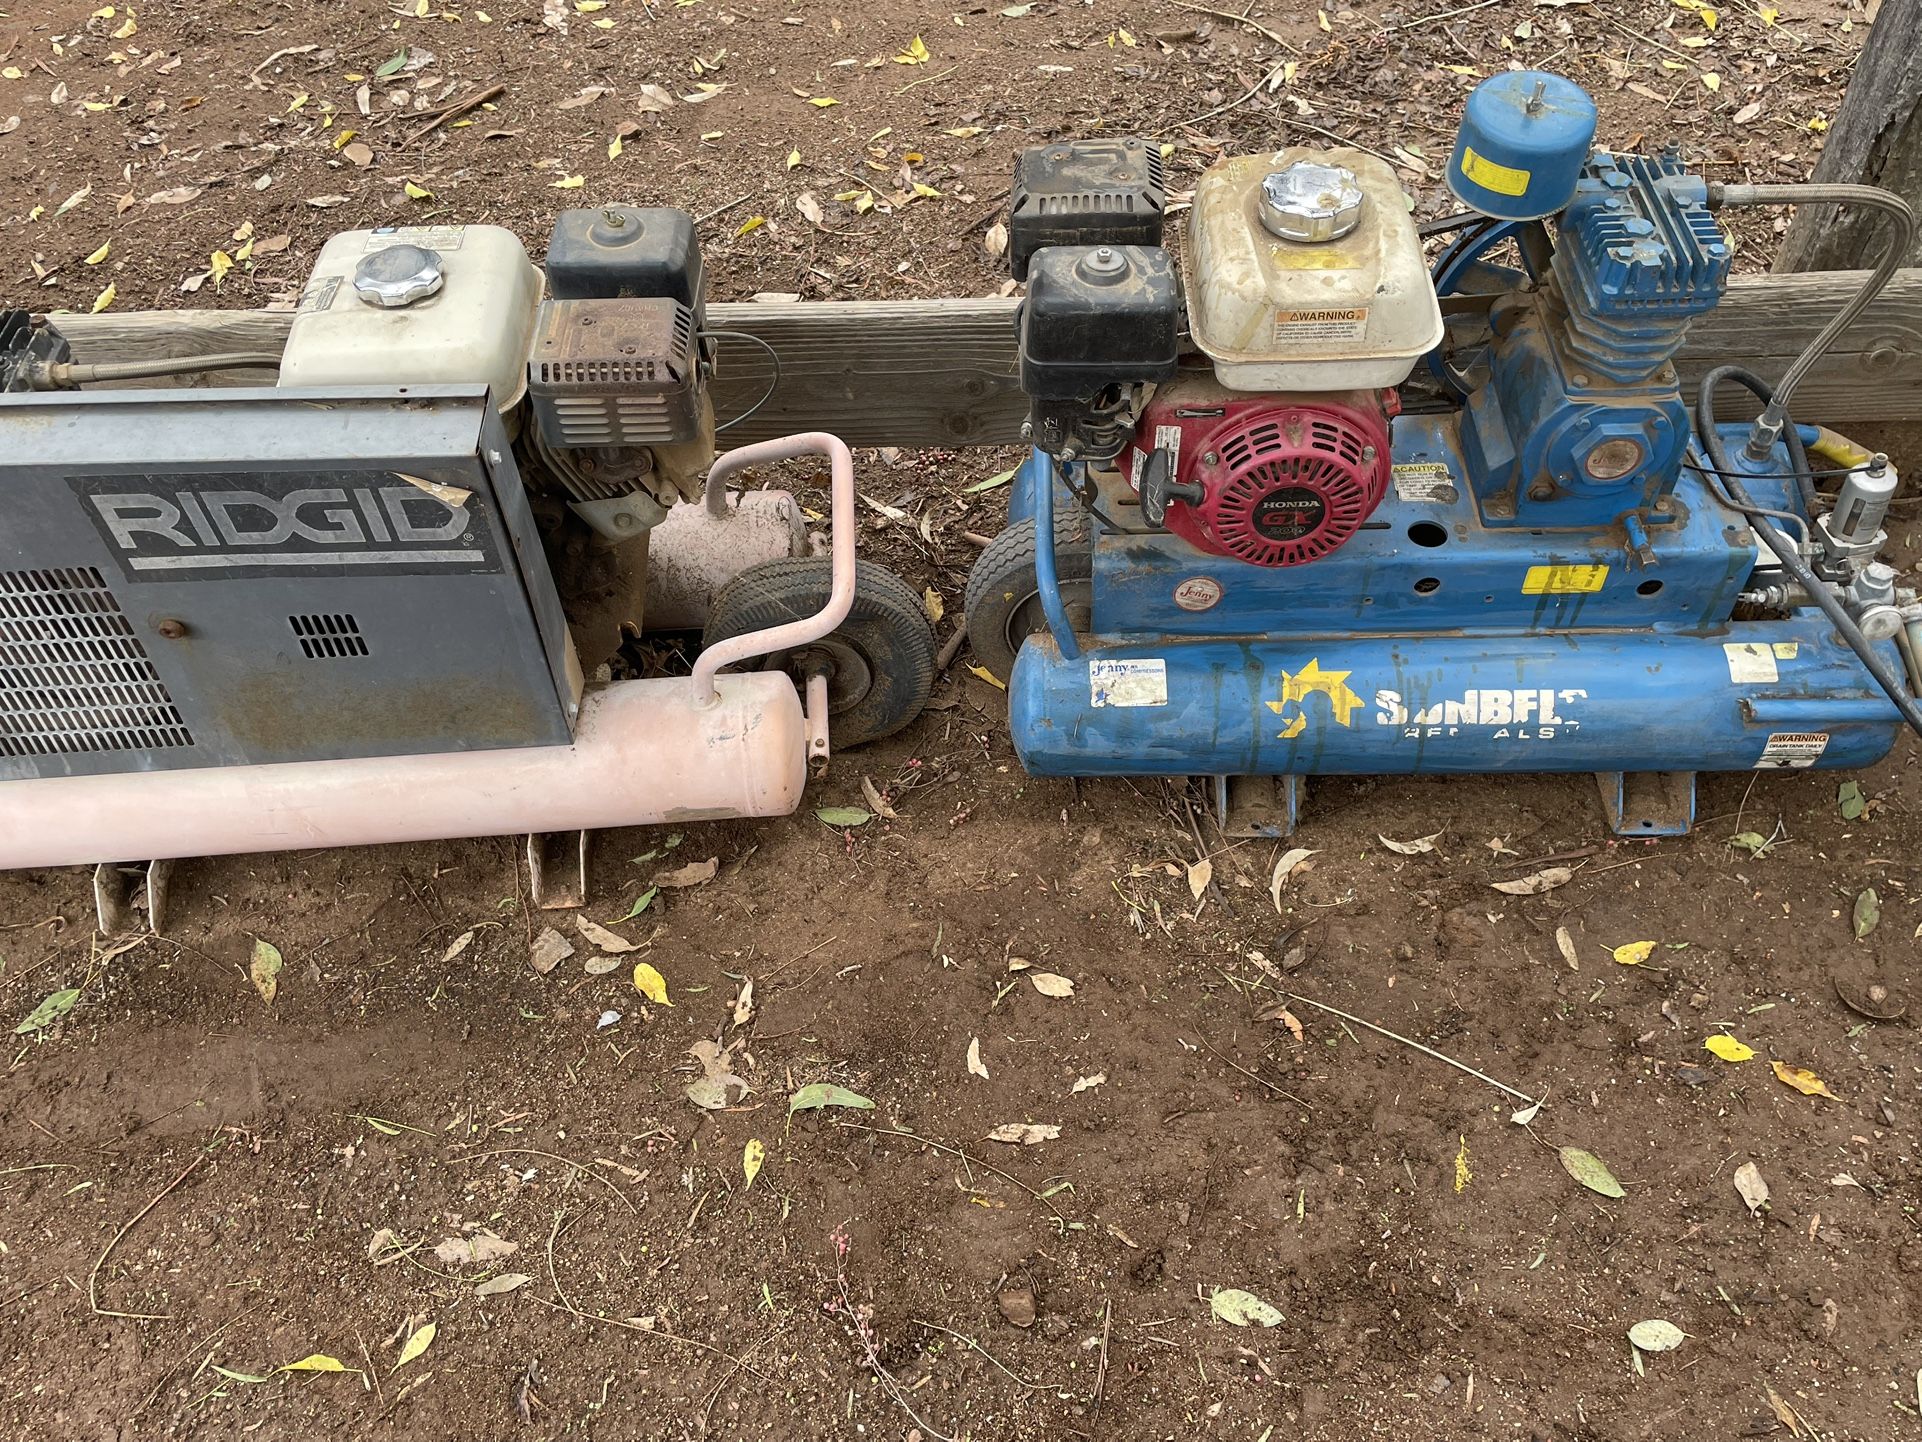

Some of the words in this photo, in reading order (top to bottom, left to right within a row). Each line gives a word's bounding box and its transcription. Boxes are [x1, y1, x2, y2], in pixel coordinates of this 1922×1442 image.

[1299, 310, 1355, 321] WARNING
[1400, 464, 1445, 473] CAUTION
[1263, 500, 1320, 509] HONDA
[89, 487, 471, 549] RIDGID
[1262, 511, 1316, 526] GX
[1180, 586, 1214, 602] Jenny
[1778, 734, 1828, 742] WARNING
